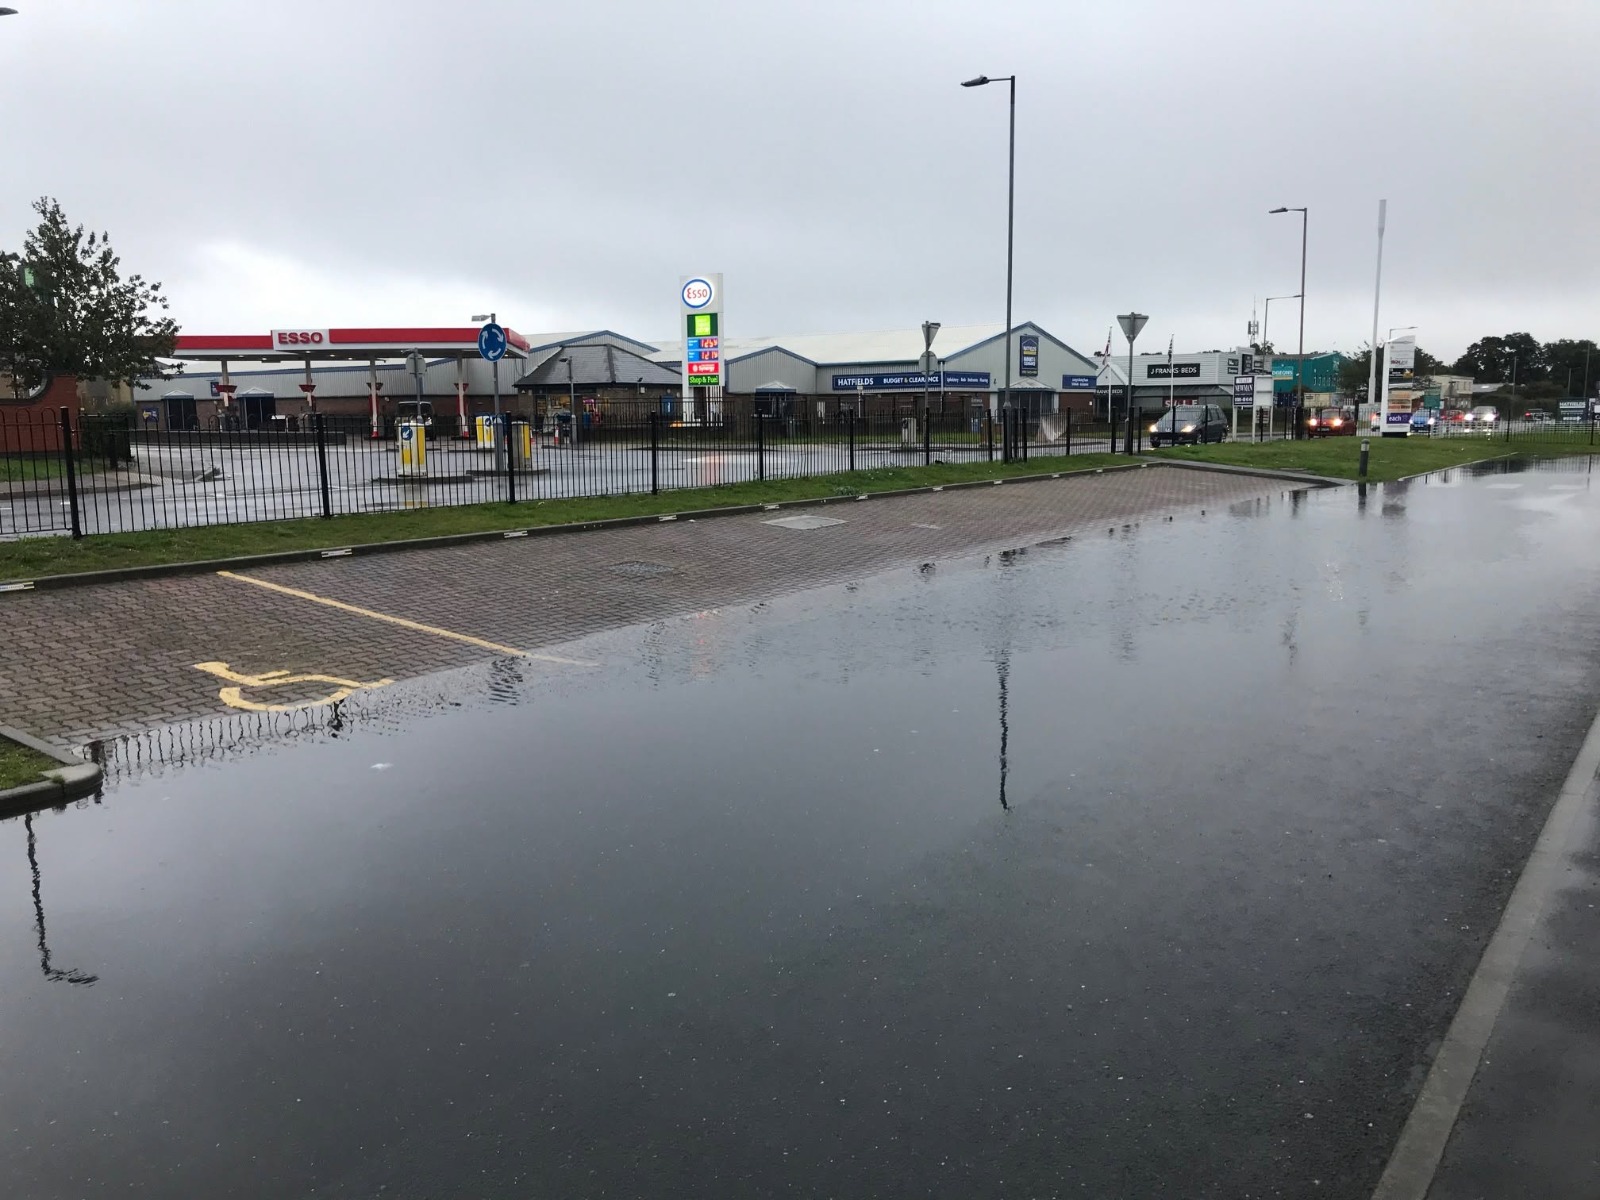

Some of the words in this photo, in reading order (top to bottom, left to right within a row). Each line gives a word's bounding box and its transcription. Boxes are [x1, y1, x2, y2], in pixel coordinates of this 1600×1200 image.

[277, 332, 324, 345] ESSO
[1181, 366, 1197, 374] BEDS
[689, 376, 703, 385] Shop
[707, 375, 719, 383] Fuel
[837, 377, 875, 386] HATFIELDS
[883, 377, 904, 385] BUDGET
[1388, 415, 1402, 423] each
